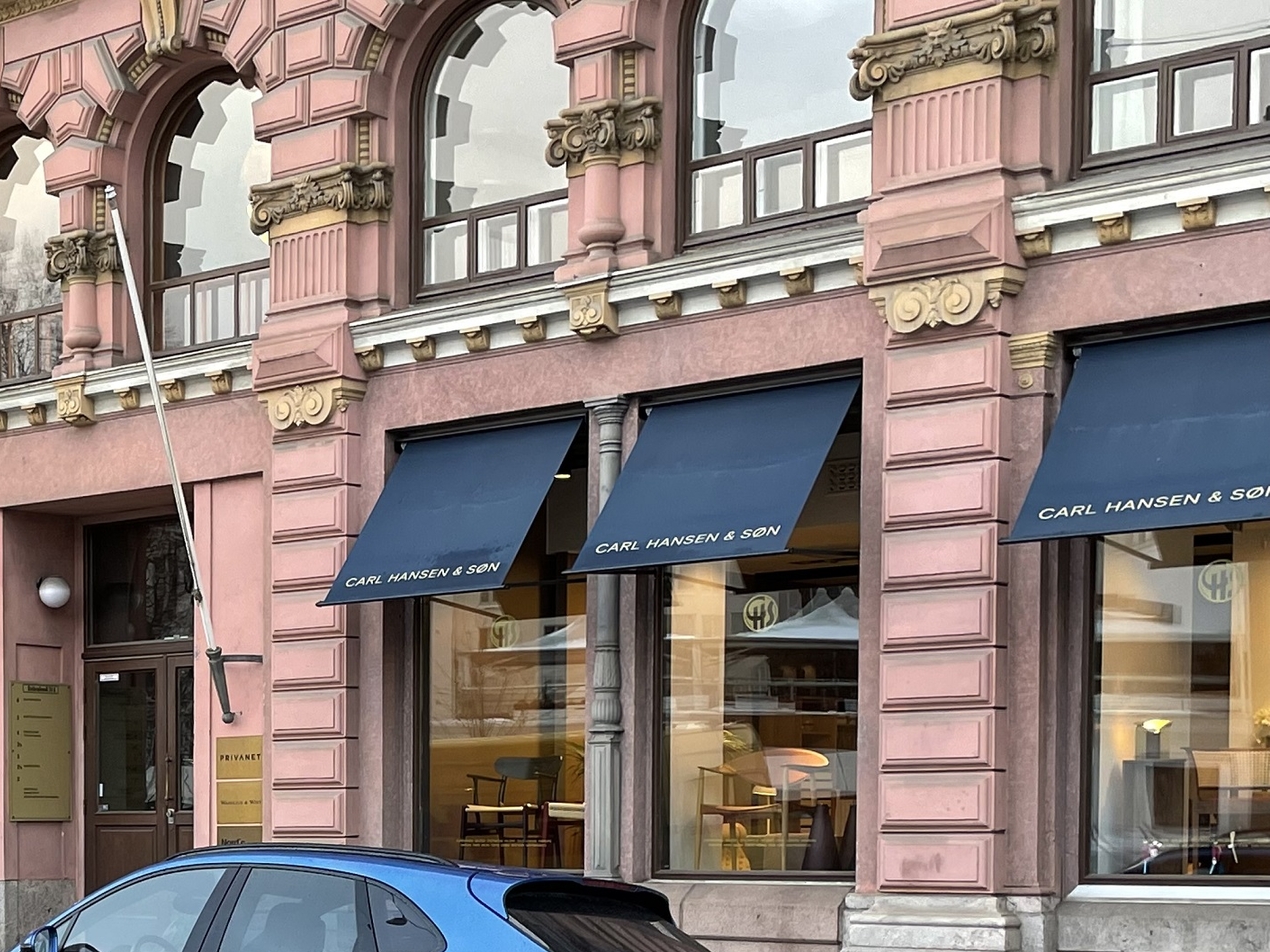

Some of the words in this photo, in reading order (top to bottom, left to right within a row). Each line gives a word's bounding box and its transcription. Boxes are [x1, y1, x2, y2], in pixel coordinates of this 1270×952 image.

[1038, 504, 1096, 520] CARL
[1105, 493, 1201, 513] HANSEN
[1208, 490, 1222, 503] &
[595, 541, 640, 554] CARL
[646, 532, 719, 549] HANSEN
[723, 530, 736, 541] &
[740, 524, 781, 539] SØN
[345, 574, 383, 588] CARL
[387, 567, 450, 583] HANSEN
[452, 565, 463, 576] &
[465, 561, 500, 575] SØN
[219, 753, 261, 761] PRIVANET
